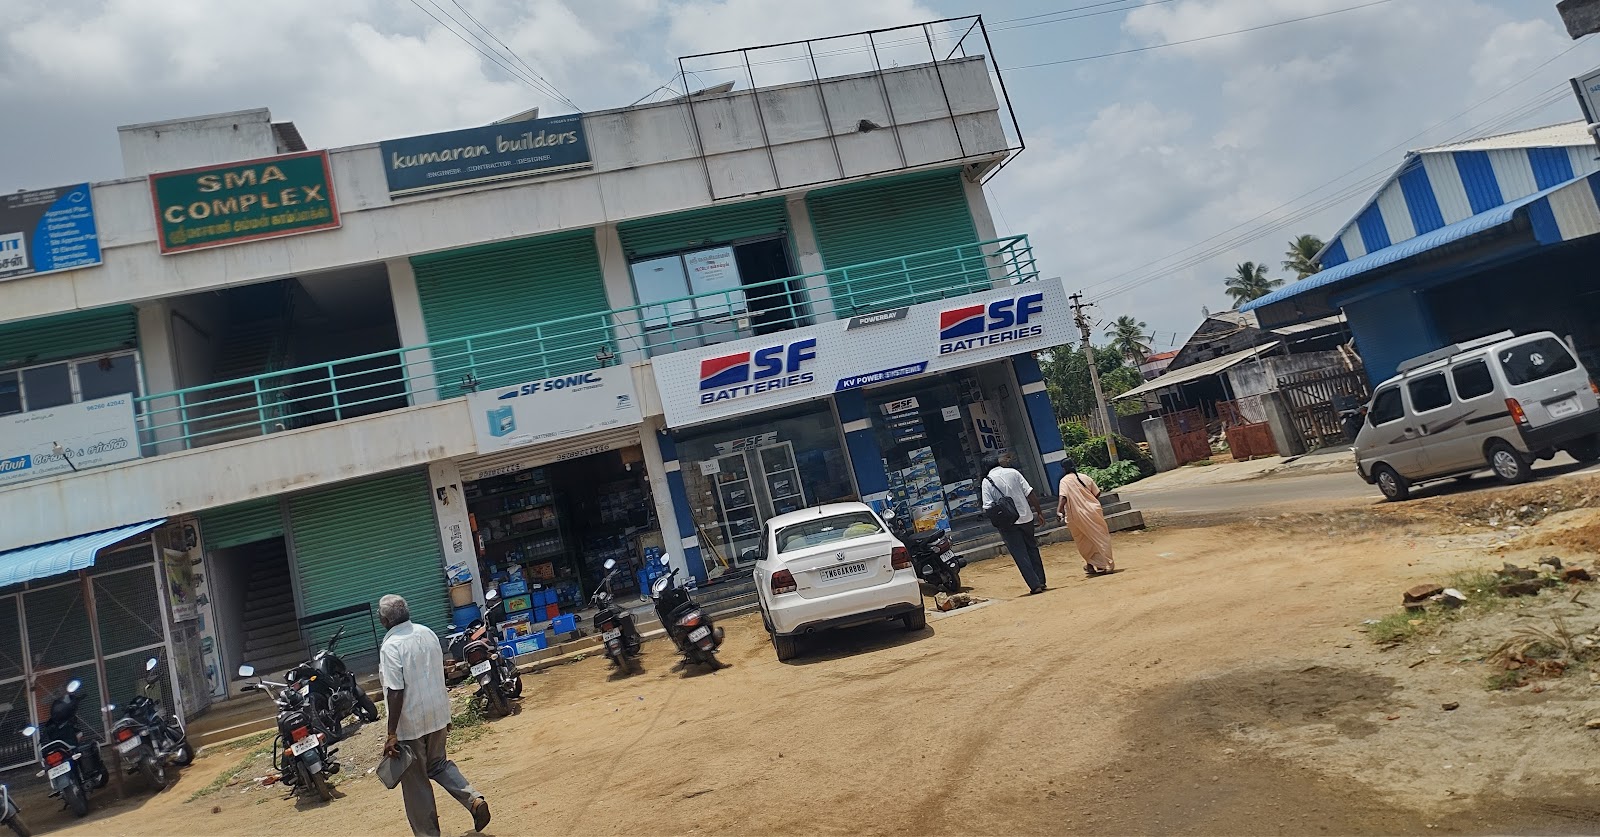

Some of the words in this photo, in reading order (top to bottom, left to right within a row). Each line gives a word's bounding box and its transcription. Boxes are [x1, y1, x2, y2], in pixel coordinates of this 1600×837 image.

[392, 142, 490, 170] kumaran
[496, 129, 578, 154] builders
[196, 165, 288, 193] SMA
[164, 184, 324, 223] COMPLEX
[859, 312, 898, 325] POWERBAY
[988, 292, 1043, 331] SF
[939, 325, 1042, 355] BATTERIES
[753, 337, 817, 380] SF
[519, 382, 541, 397] SF
[543, 372, 602, 392] SONIC
[700, 371, 814, 405] BATTERIES
[843, 377, 856, 388] KV
[856, 371, 884, 385] POWER
[885, 364, 922, 380] SYSTEMS
[743, 435, 762, 447] SF
